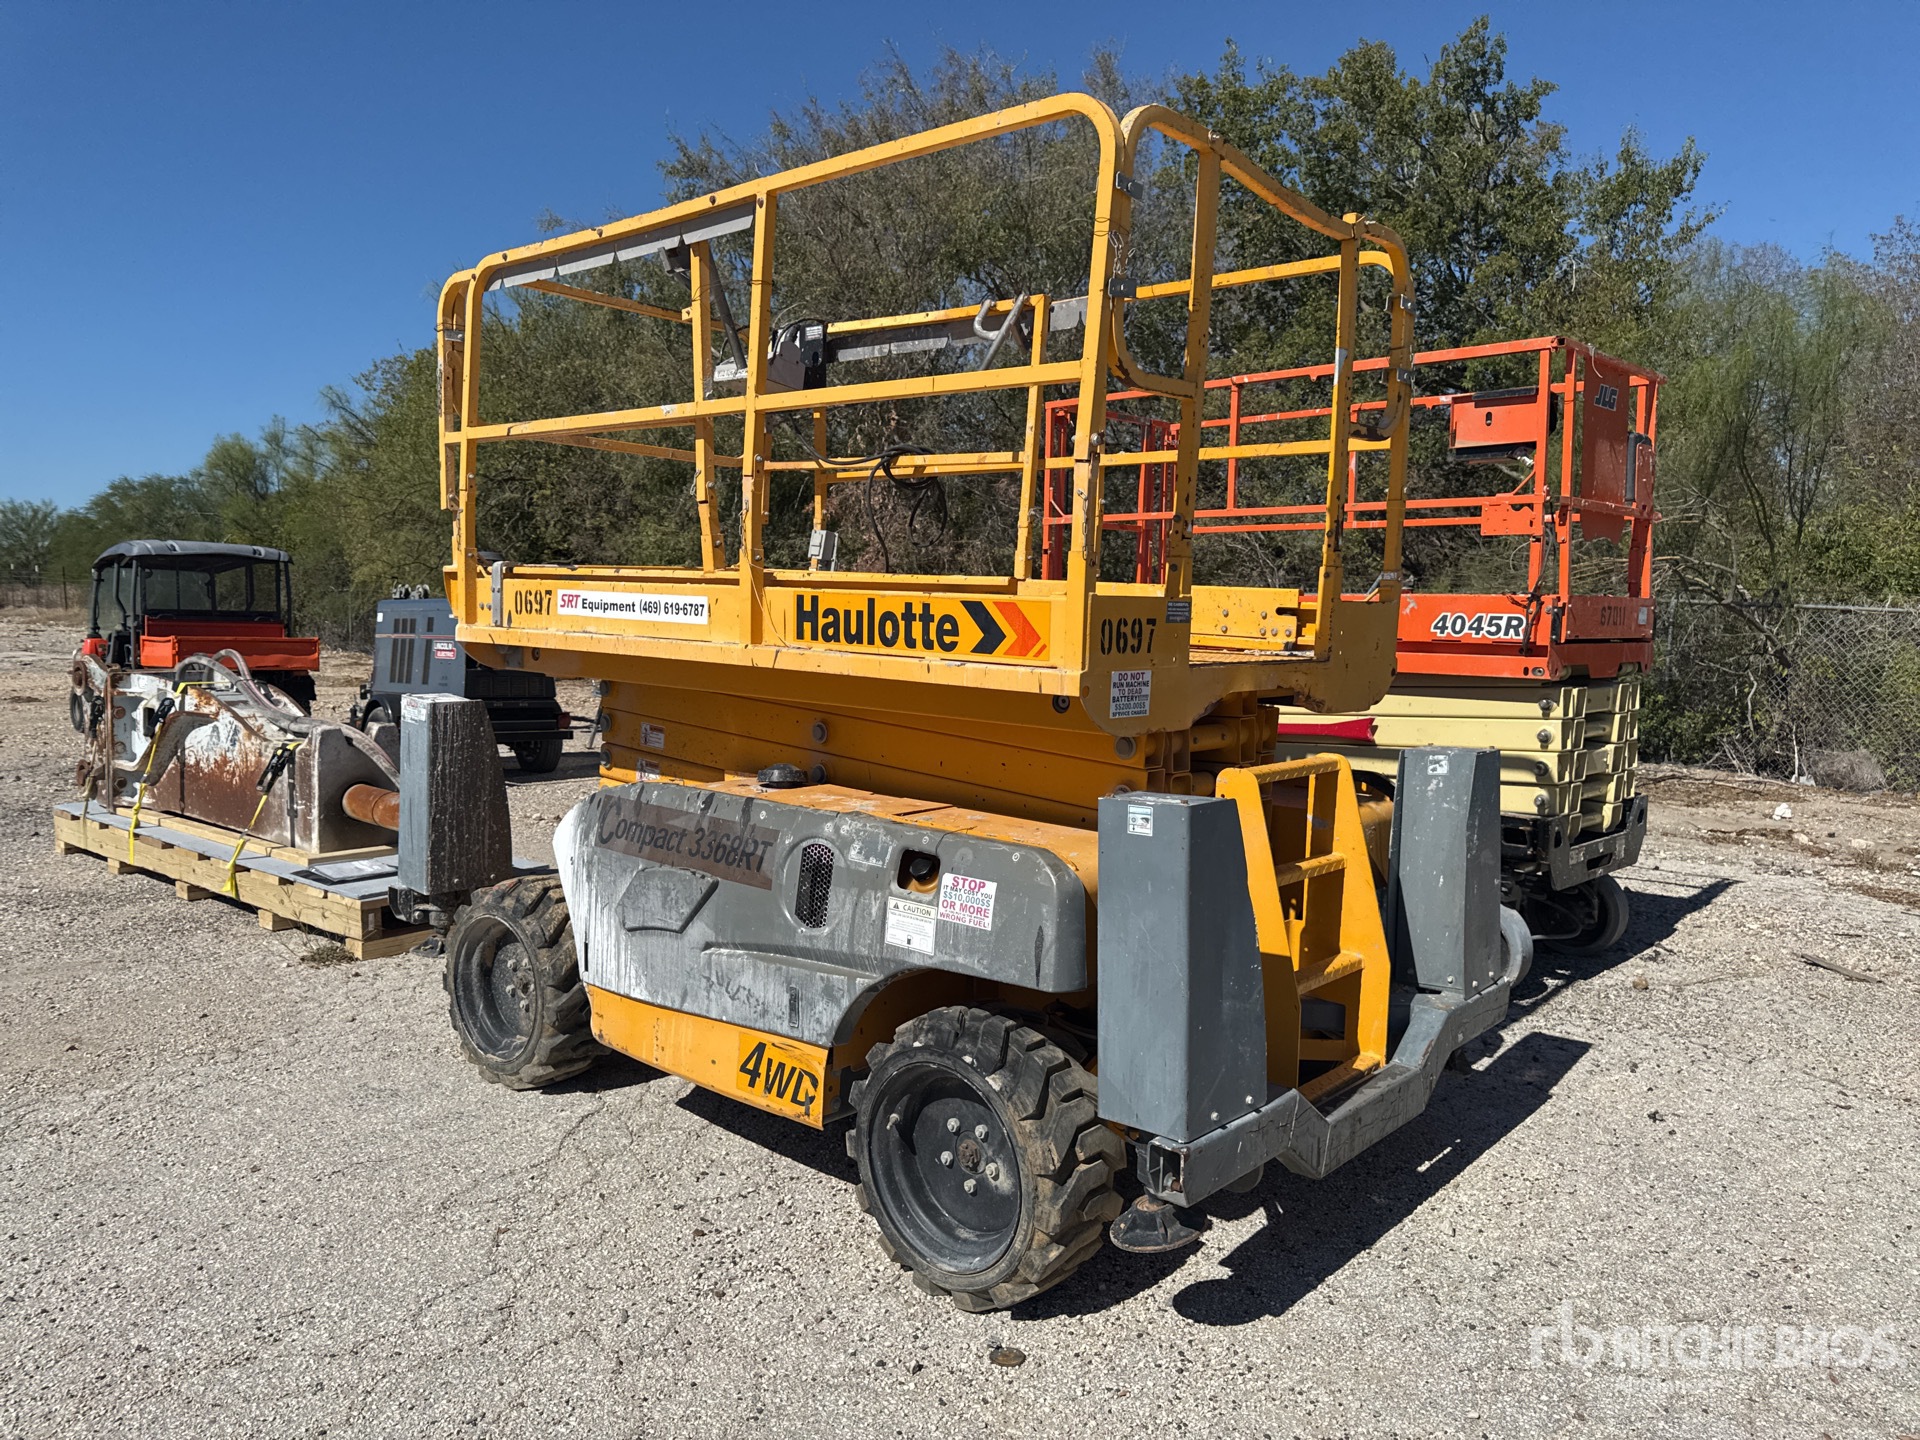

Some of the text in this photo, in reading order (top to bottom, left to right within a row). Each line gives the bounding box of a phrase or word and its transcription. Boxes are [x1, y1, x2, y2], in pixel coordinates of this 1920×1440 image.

[1594, 384, 1619, 411] JLG
[514, 590, 552, 615] 0697
[560, 593, 705, 617] SRT Equipment (469) 619-6787
[796, 594, 959, 652] Haulotte
[1430, 612, 1526, 639] 4045R
[1100, 618, 1157, 655] 0697
[1118, 672, 1145, 681] DO NOT
[597, 796, 774, 873] Compact 3368RT
[952, 876, 986, 892] STOP
[903, 904, 932, 917] CAUTION
[942, 899, 990, 918] OR MORE
[943, 891, 991, 908] $$10,000$$
[940, 912, 967, 923] WRONG
[968, 919, 990, 928] FUEL!
[739, 1042, 819, 1106] 4WD
